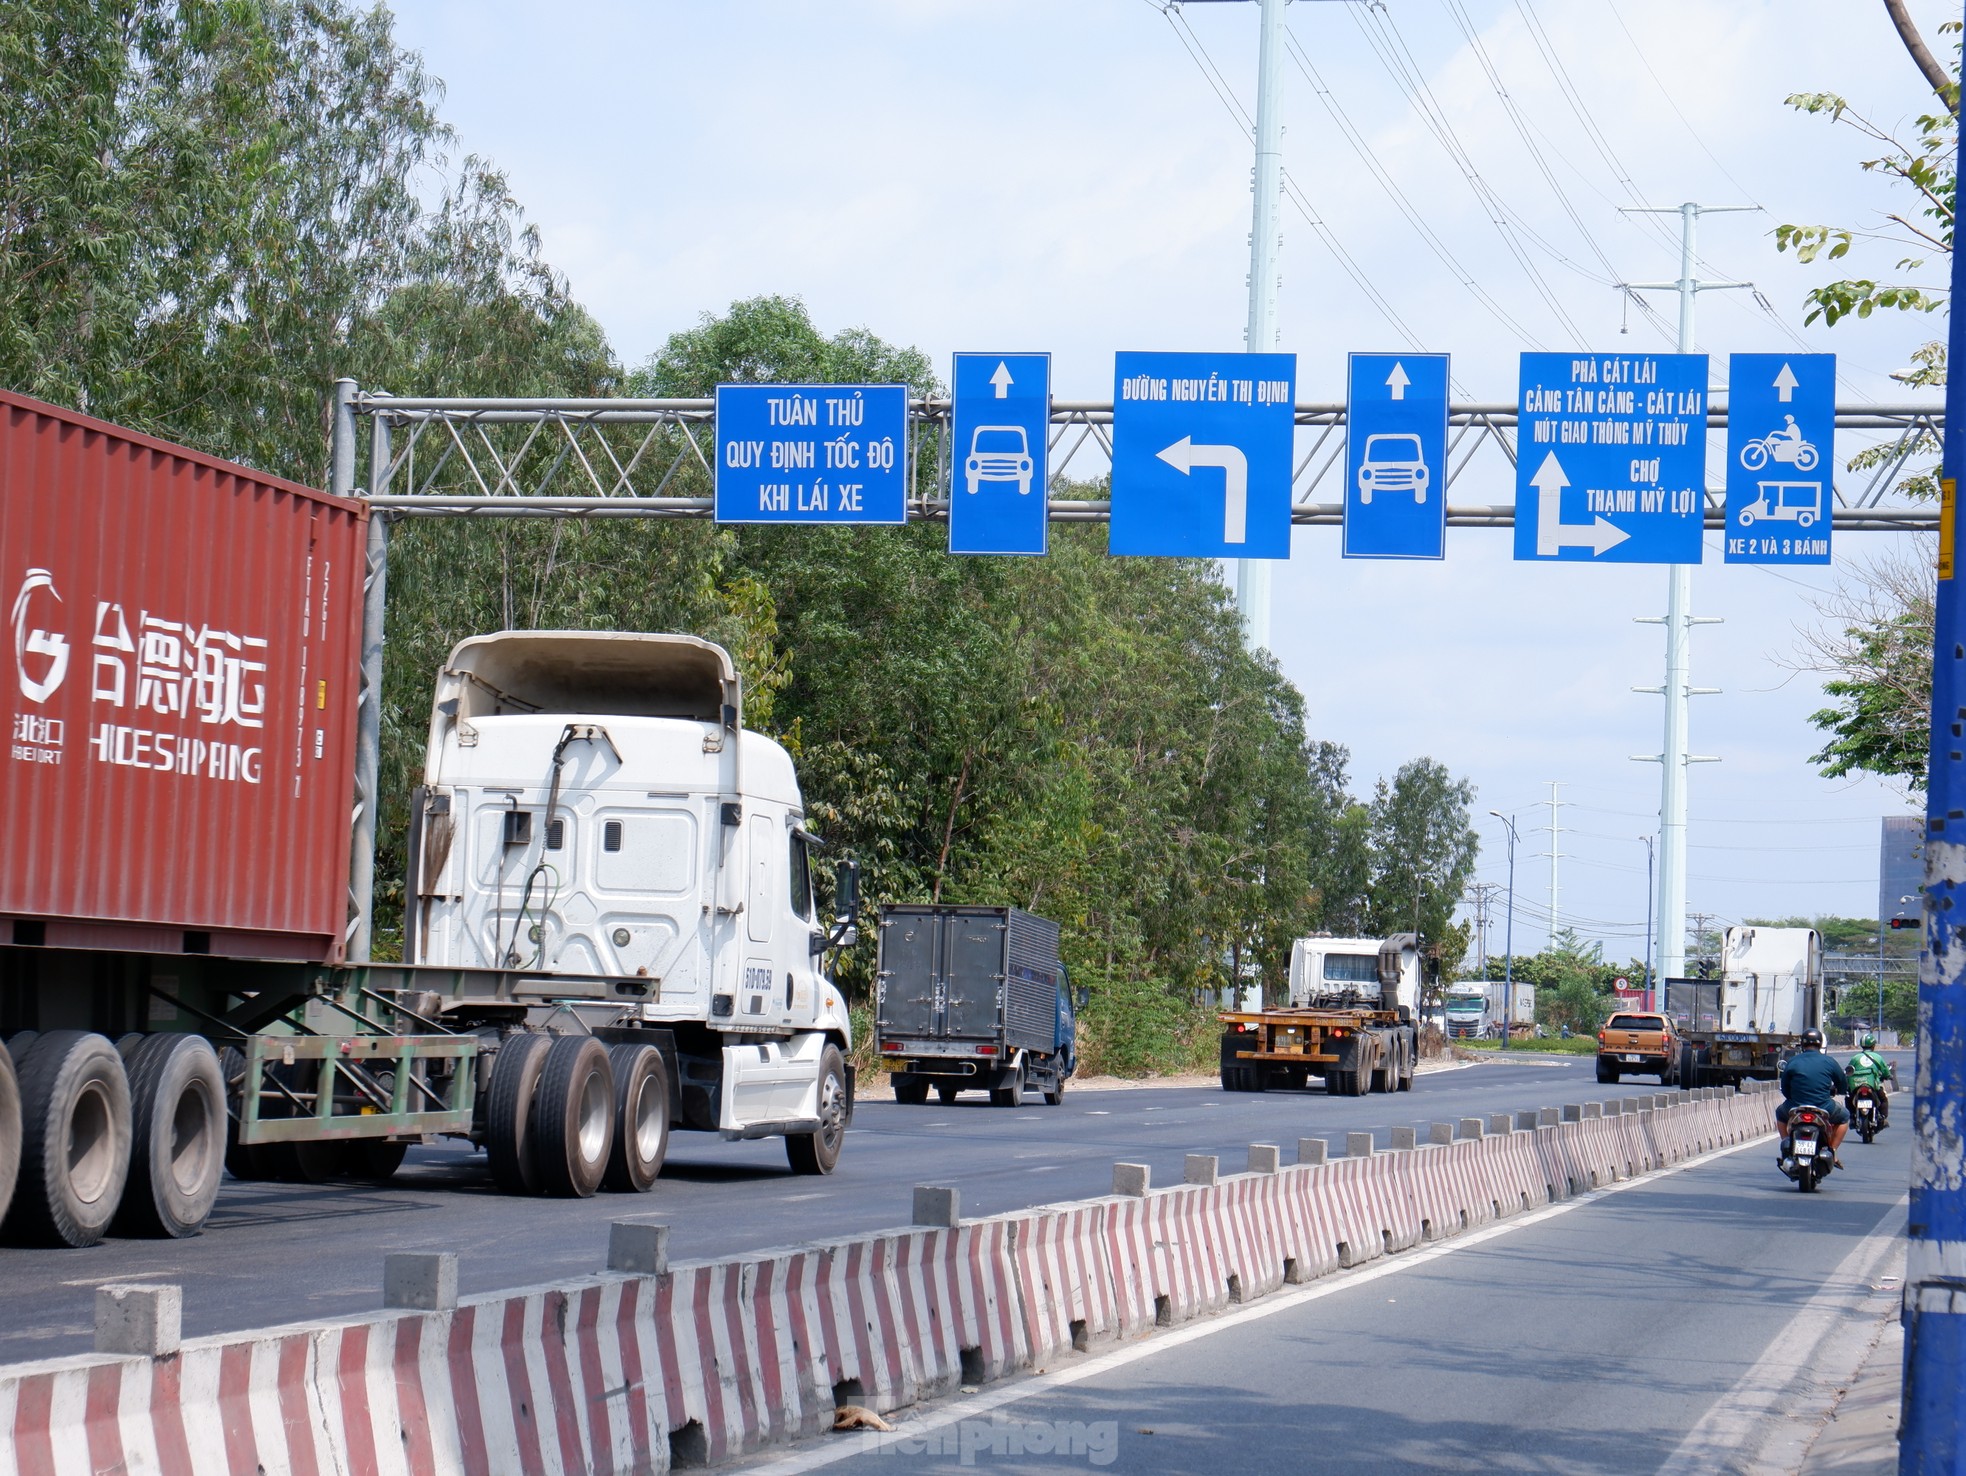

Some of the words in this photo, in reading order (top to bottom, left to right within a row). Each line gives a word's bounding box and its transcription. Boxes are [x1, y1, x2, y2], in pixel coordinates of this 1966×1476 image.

[1571, 356, 1598, 382] PHÀ
[1602, 357, 1630, 384] CÁT
[1633, 357, 1657, 384] LÁI
[1122, 374, 1168, 401] ĐƯỜNG
[1171, 371, 1228, 402] NGUYỄN
[1231, 379, 1253, 407] THỊ
[1257, 380, 1289, 407] ĐỊNH
[1525, 384, 1562, 413] CẢNG
[1566, 386, 1594, 414] TÂN
[1597, 385, 1635, 414] CẢNG
[1646, 388, 1675, 415] CÁT
[1678, 388, 1701, 415] LÁI
[767, 393, 817, 426] TUÂN
[825, 390, 864, 427] THỦ
[1534, 416, 1558, 443] NÚT
[1560, 420, 1588, 444] GIAO
[1592, 417, 1630, 445] THÔNG
[1632, 418, 1654, 445] MỸ
[1658, 416, 1689, 446] THỦY
[726, 440, 765, 468] QUY
[770, 441, 815, 473] ĐỊNH
[823, 432, 860, 469] TỐC
[866, 436, 894, 474] ĐỘ
[1630, 457, 1661, 485] CHỢ
[759, 484, 790, 512] KHI
[797, 477, 828, 511] LÁI
[838, 484, 863, 512] XE
[1586, 489, 1636, 516] THẠNH
[1640, 487, 1666, 513] MỸ
[1671, 487, 1696, 518] LỢI
[1728, 538, 1746, 555] XE
[1749, 538, 1757, 555] 2
[1761, 536, 1778, 555] VÀ
[1782, 539, 1791, 555] 3
[1794, 537, 1828, 556] BÁNH
